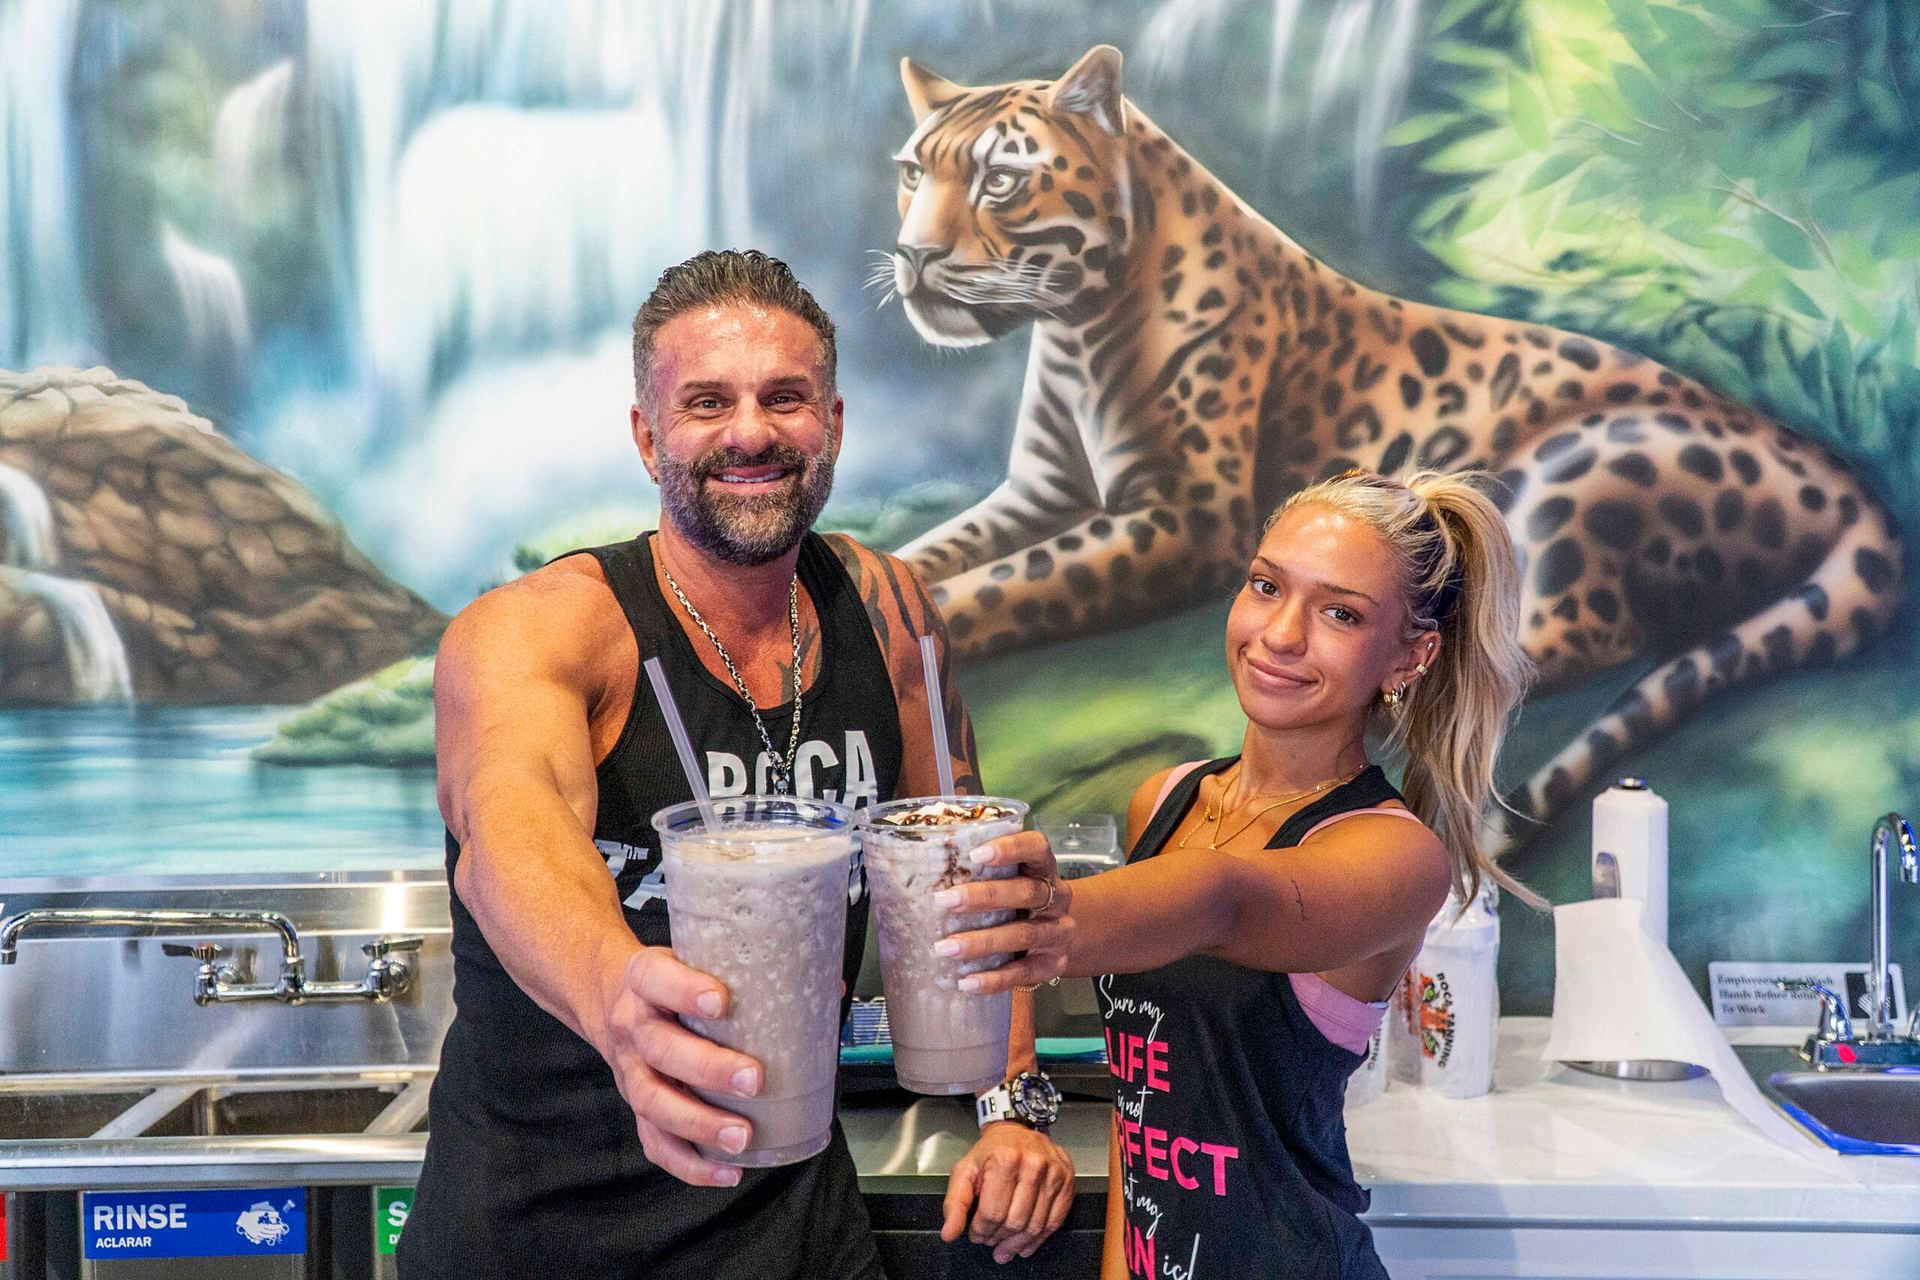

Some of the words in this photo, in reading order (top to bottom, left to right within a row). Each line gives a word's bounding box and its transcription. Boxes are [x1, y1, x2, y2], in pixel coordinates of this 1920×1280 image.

[706, 730, 880, 822] BOCA
[1100, 974, 1137, 1019] Sure
[1139, 1001, 1165, 1044] my
[1436, 972, 1453, 1009] BOCA
[1719, 989, 1752, 1000] Hands
[1754, 989, 1788, 1000] Before
[1721, 1003, 1735, 1014] To
[1736, 1004, 1766, 1015] Work
[1105, 1026, 1171, 1093] LIFE
[1438, 1012, 1455, 1069] TANNING
[1125, 1085, 1154, 1128] not
[93, 1202, 188, 1232] RINSE
[1136, 1196, 1163, 1240] my
[95, 1236, 152, 1249] ACLARAR
